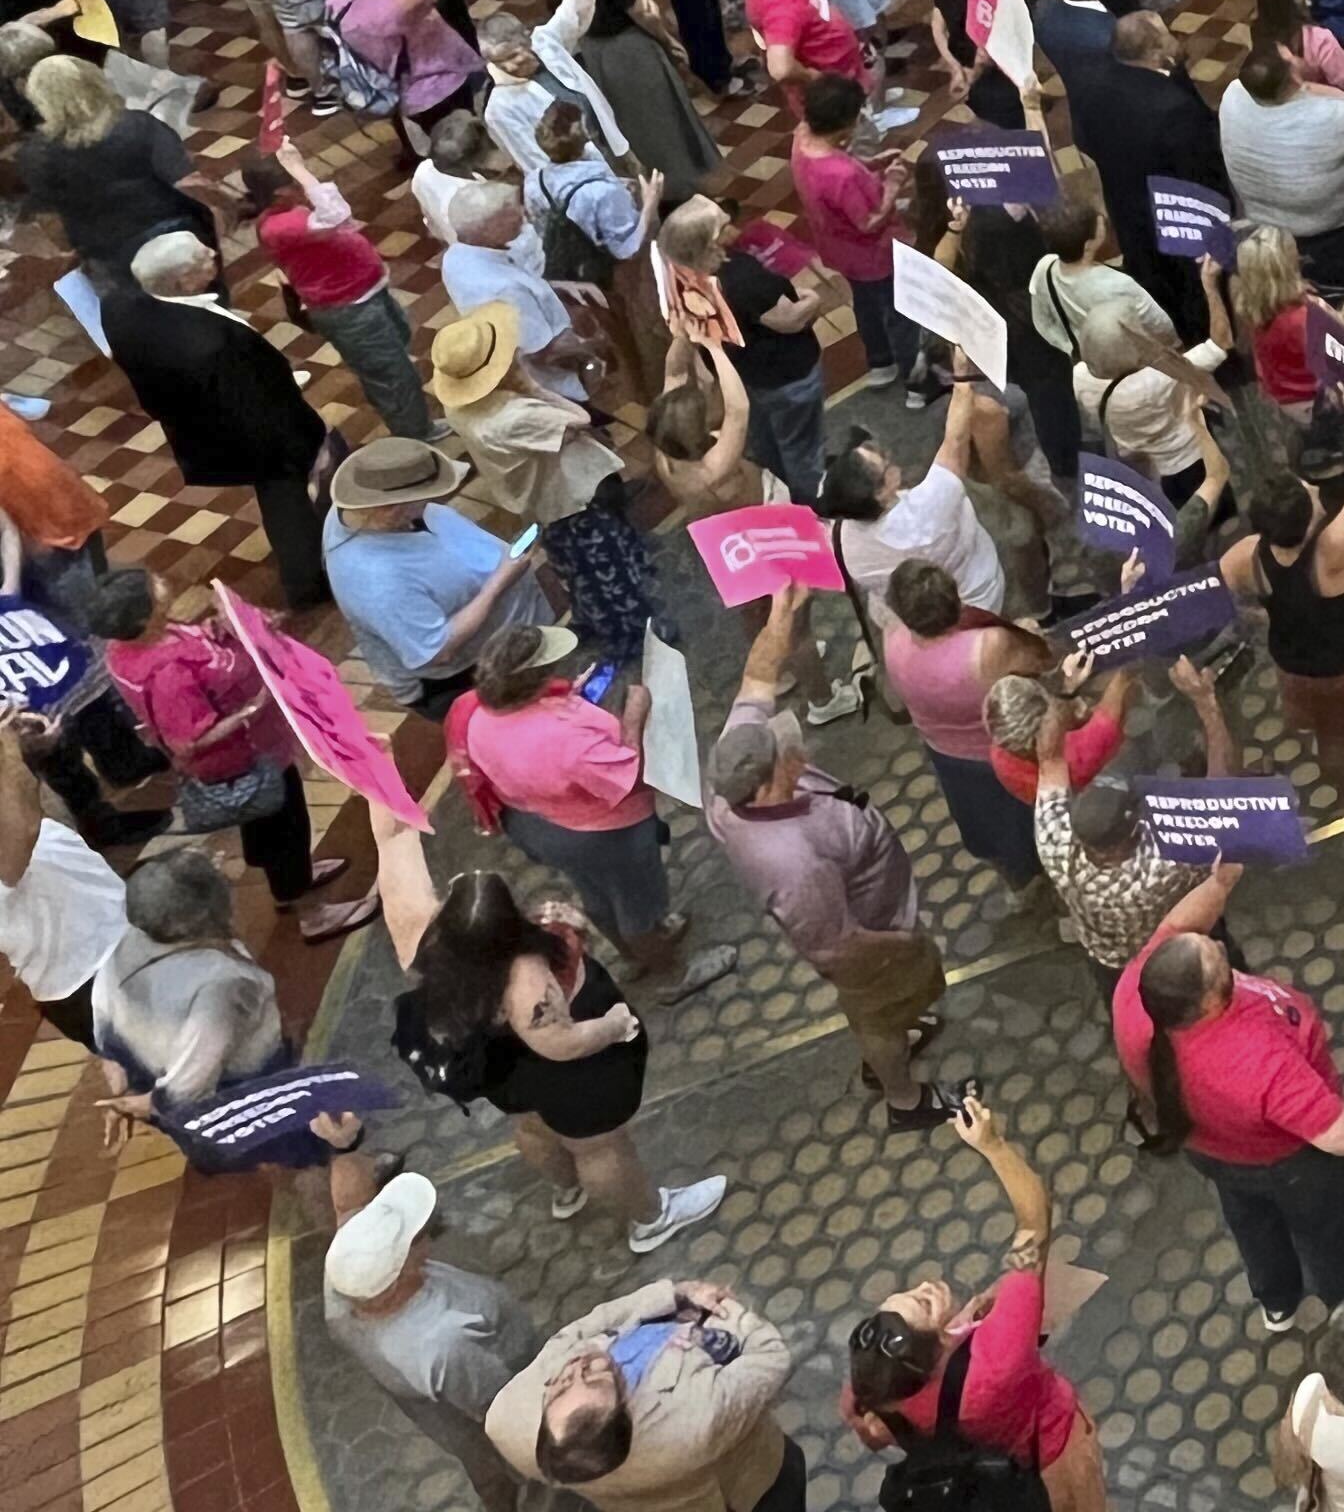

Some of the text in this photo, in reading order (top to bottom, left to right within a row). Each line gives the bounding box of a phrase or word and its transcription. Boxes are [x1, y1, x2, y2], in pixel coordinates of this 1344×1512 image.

[1145, 795, 1290, 810] REPRODUCTIVE
[1152, 813, 1240, 828] FREEDOM
[1158, 831, 1218, 847] VOTER
